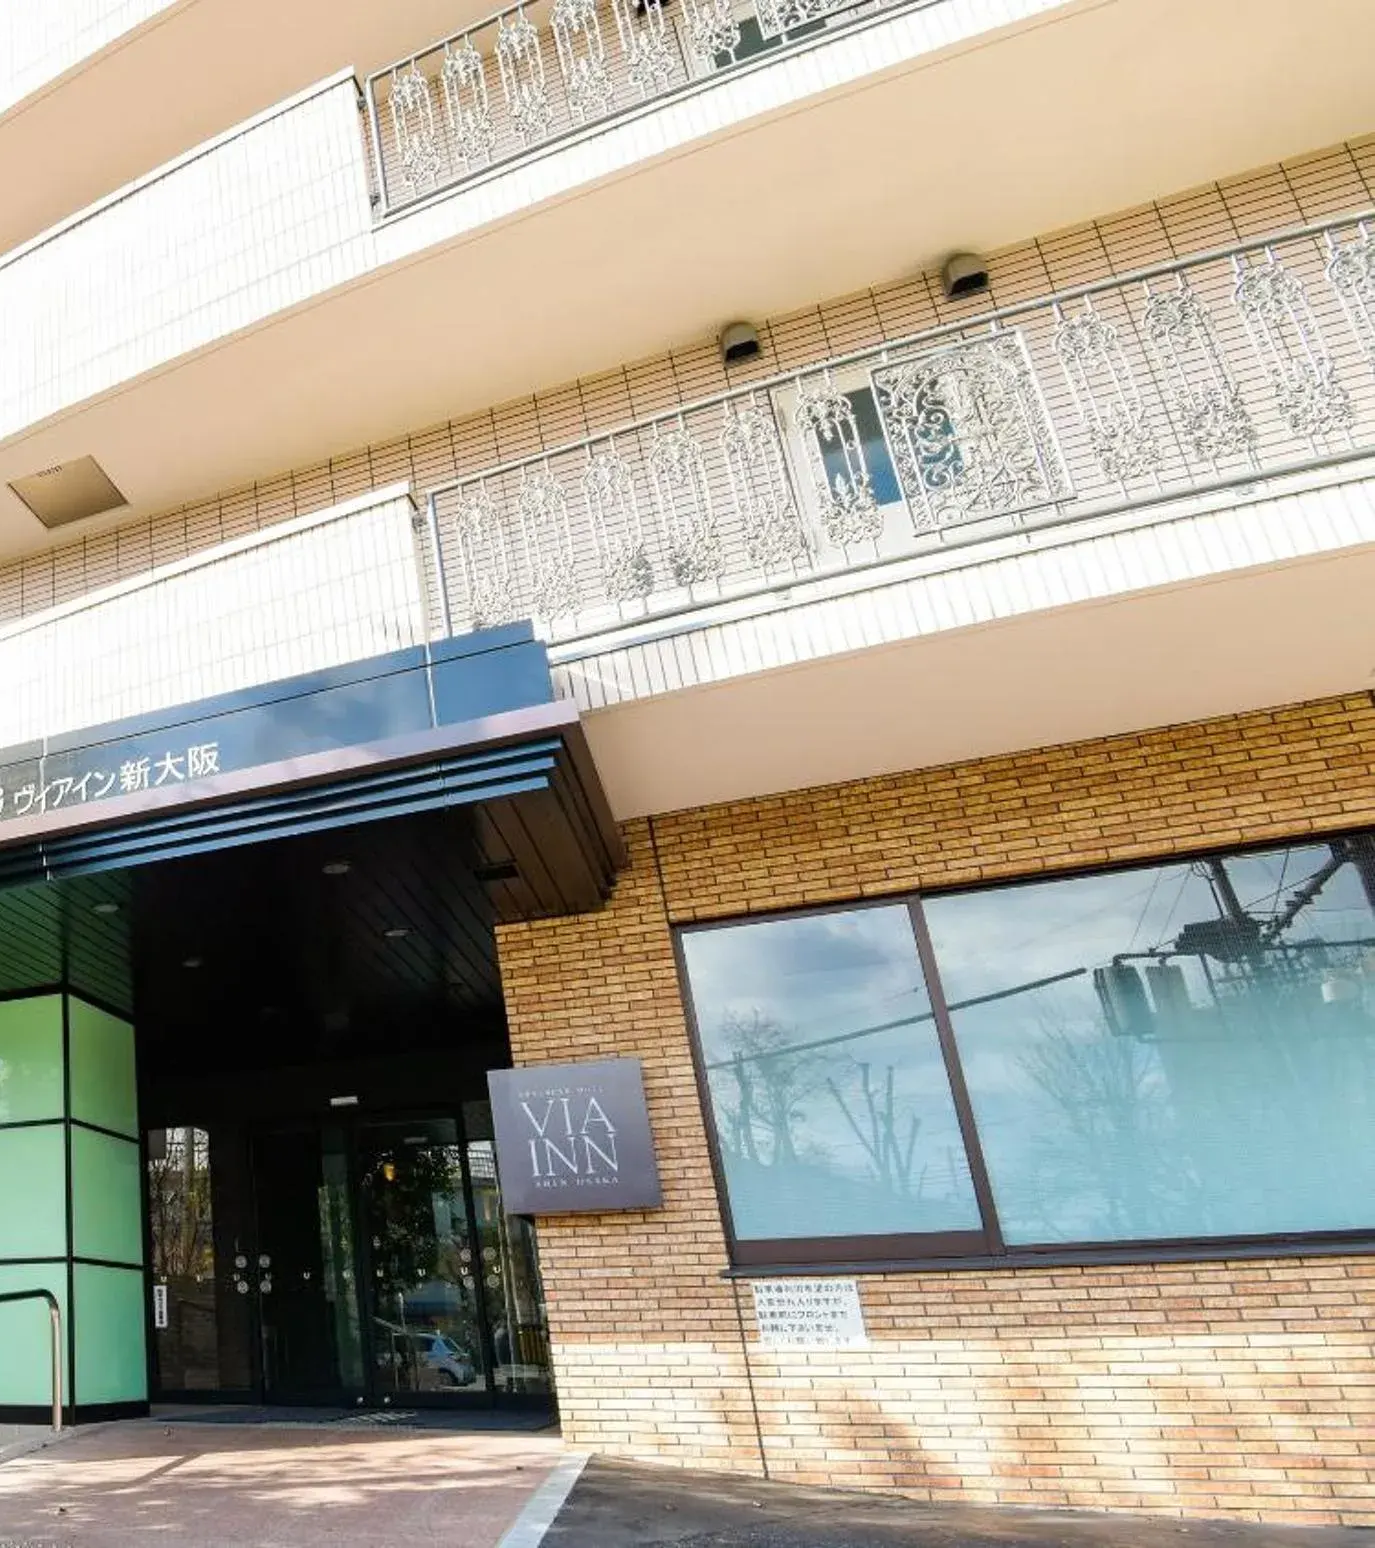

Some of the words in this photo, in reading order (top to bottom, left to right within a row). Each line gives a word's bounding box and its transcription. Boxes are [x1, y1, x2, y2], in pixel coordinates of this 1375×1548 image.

[12, 742, 220, 816] ヴィアイン新大阪
[520, 1097, 617, 1136] VIA
[528, 1133, 619, 1177] INN
